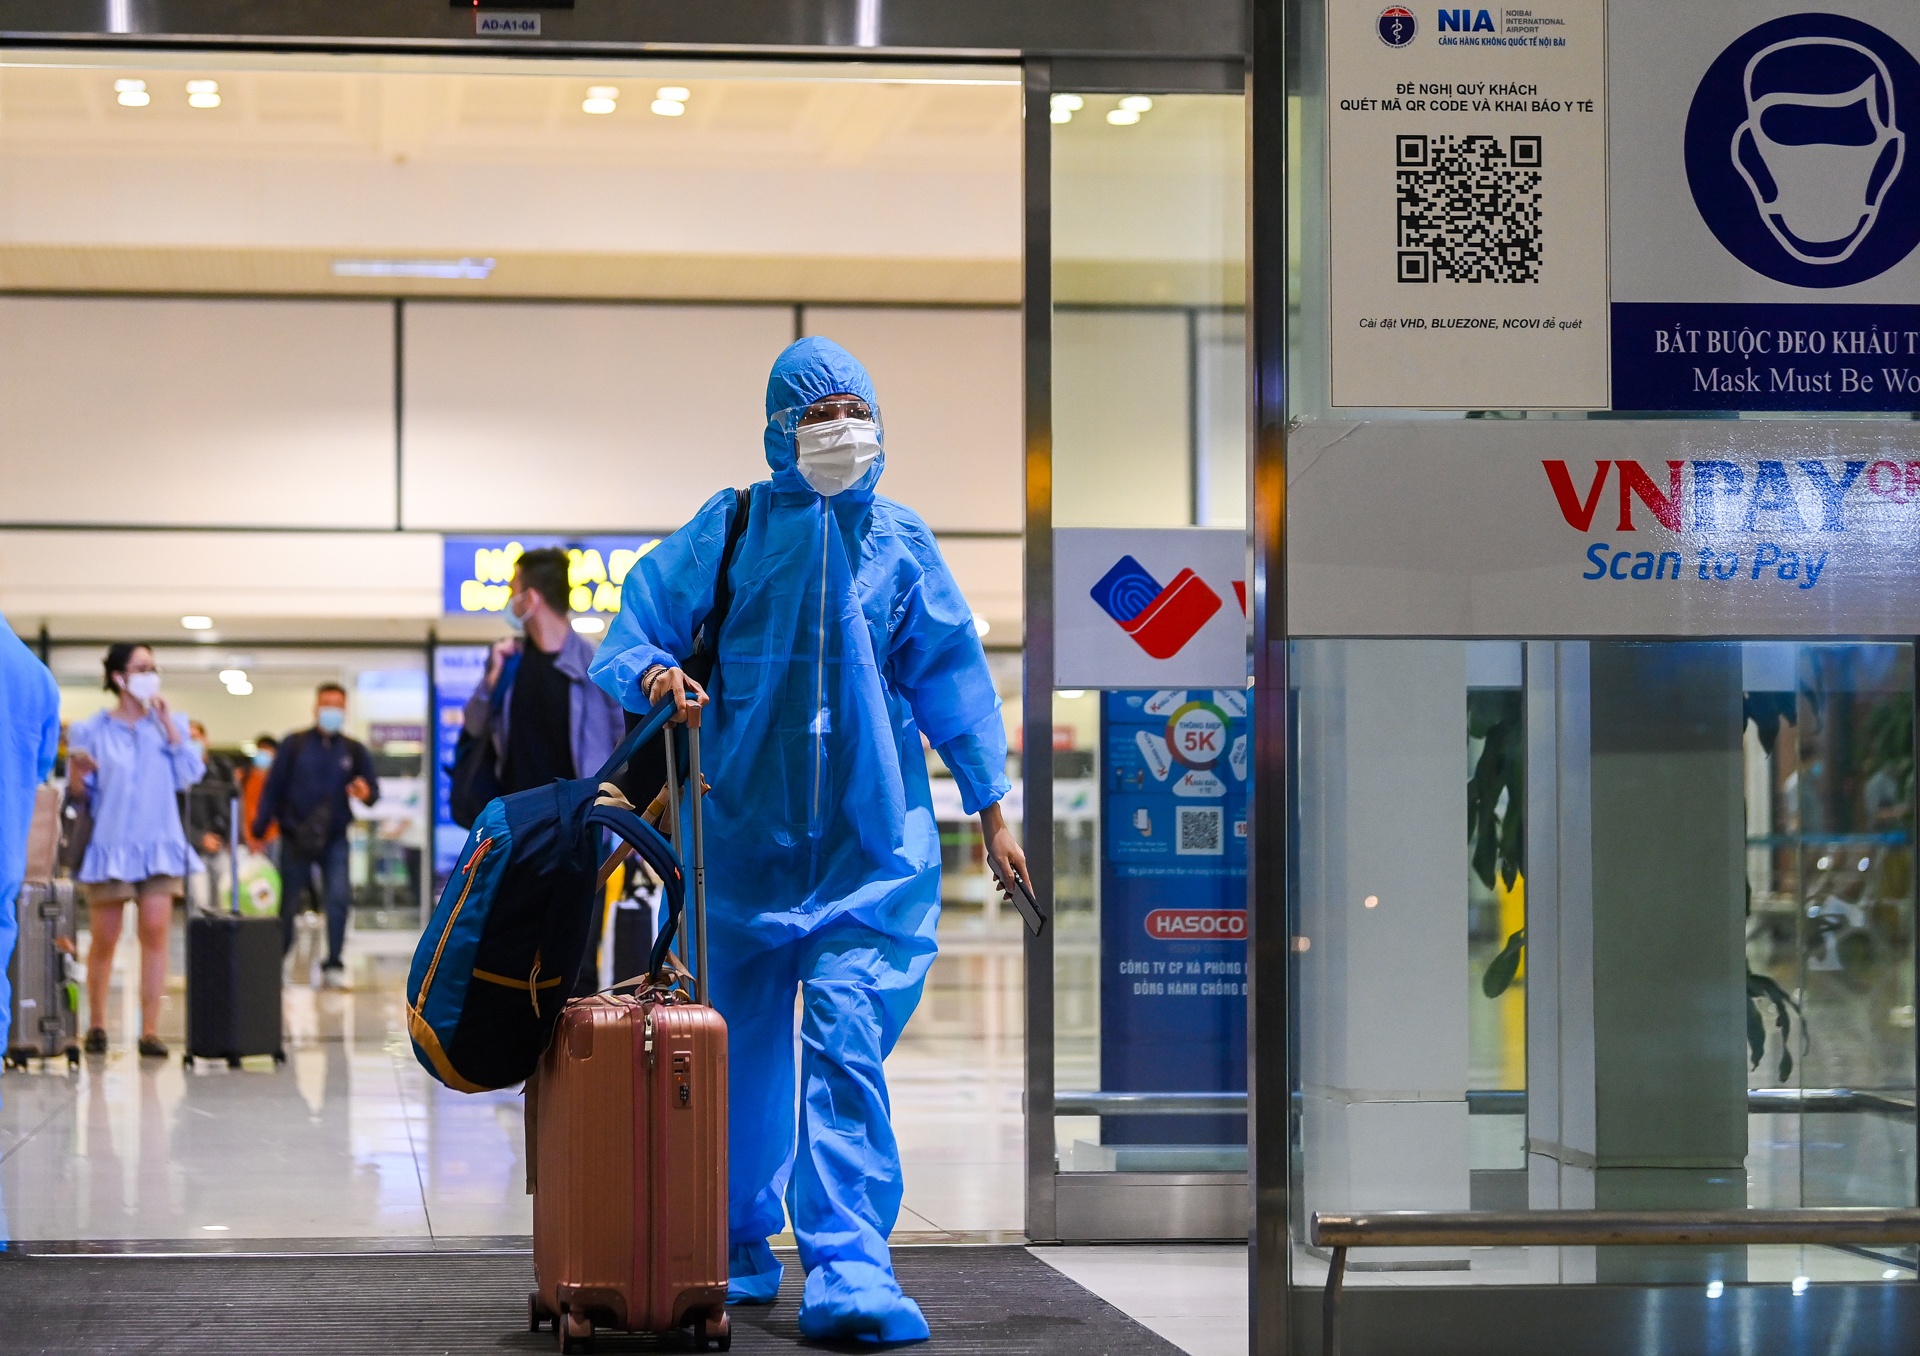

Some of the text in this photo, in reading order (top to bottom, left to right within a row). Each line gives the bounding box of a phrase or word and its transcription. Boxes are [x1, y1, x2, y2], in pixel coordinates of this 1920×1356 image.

[482, 20, 535, 30] AD-A1-04
[1438, 9, 1495, 32] NIA
[1419, 84, 1452, 98] NGHỊ
[1456, 81, 1485, 95] QUÝ
[1489, 82, 1537, 95] KHÁCH
[1340, 97, 1378, 111] QUÉT
[1381, 97, 1402, 111] MÃ
[1405, 100, 1426, 111] QR
[1429, 100, 1468, 111] CODE
[1472, 98, 1491, 112] VÀ
[1495, 101, 1527, 112] KHAI
[1531, 98, 1560, 112] BÁO
[1564, 101, 1573, 112] Y
[1400, 318, 1427, 329] VHD,
[1431, 318, 1498, 329] BLUEZONE,
[1502, 319, 1541, 329] NCOVI
[1558, 319, 1582, 330] quét
[1655, 323, 1920, 360] BẮT BUỘC ĐEO KHẨU T
[1692, 367, 1761, 392] Mask
[1768, 367, 1832, 393] Must
[1840, 368, 1874, 393] Be
[1583, 543, 1829, 590] Scan to Pay
[1185, 731, 1216, 752] 5K
[1156, 916, 1244, 933] HASOCO
[1119, 959, 1150, 974] CÔNG
[1153, 962, 1166, 974] TY
[1169, 962, 1183, 974] CP
